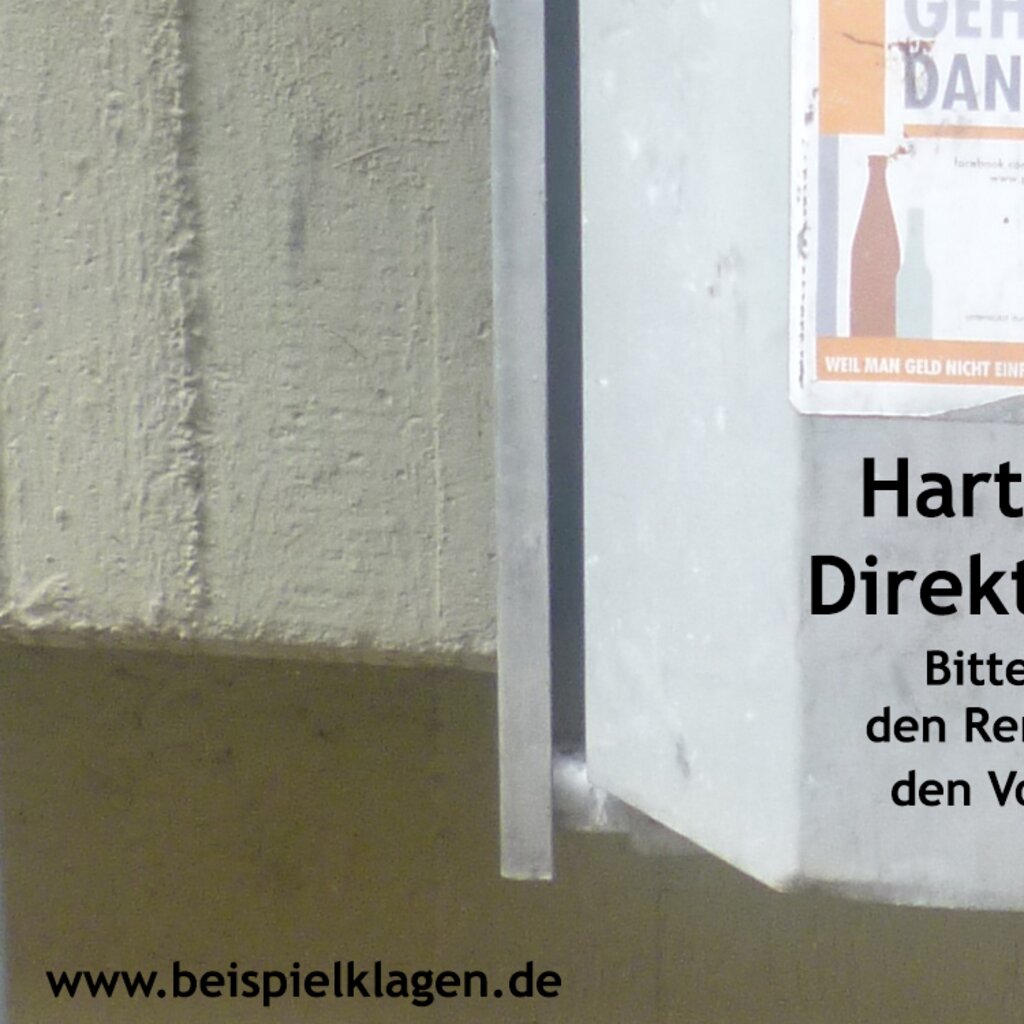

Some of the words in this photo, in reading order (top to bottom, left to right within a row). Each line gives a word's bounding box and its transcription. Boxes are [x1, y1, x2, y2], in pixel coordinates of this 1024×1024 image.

[825, 356, 861, 374] WEIL
[864, 357, 900, 374] MAN
[905, 358, 940, 375] GELD
[945, 359, 990, 377] NICHT
